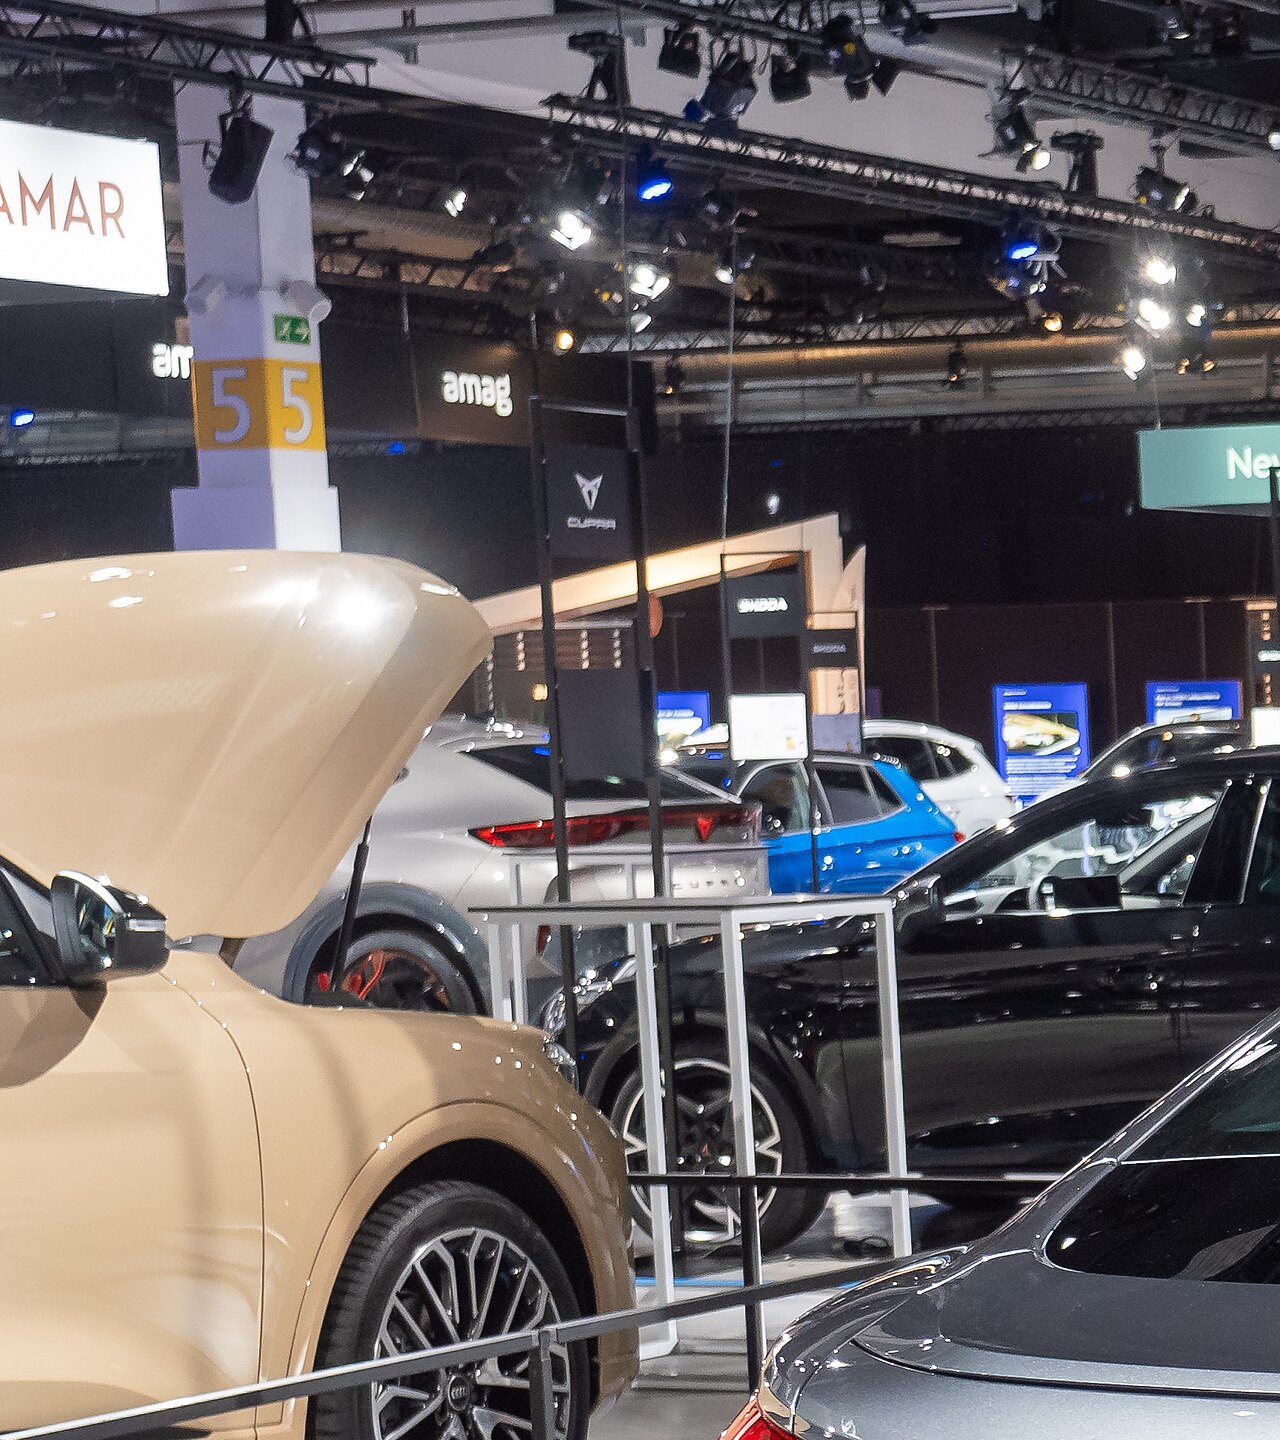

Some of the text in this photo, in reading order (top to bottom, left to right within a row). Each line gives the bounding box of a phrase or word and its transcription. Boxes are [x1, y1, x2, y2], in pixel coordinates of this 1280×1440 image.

[212, 367, 251, 442] 5
[281, 367, 313, 443] 5
[442, 371, 513, 417] amag
